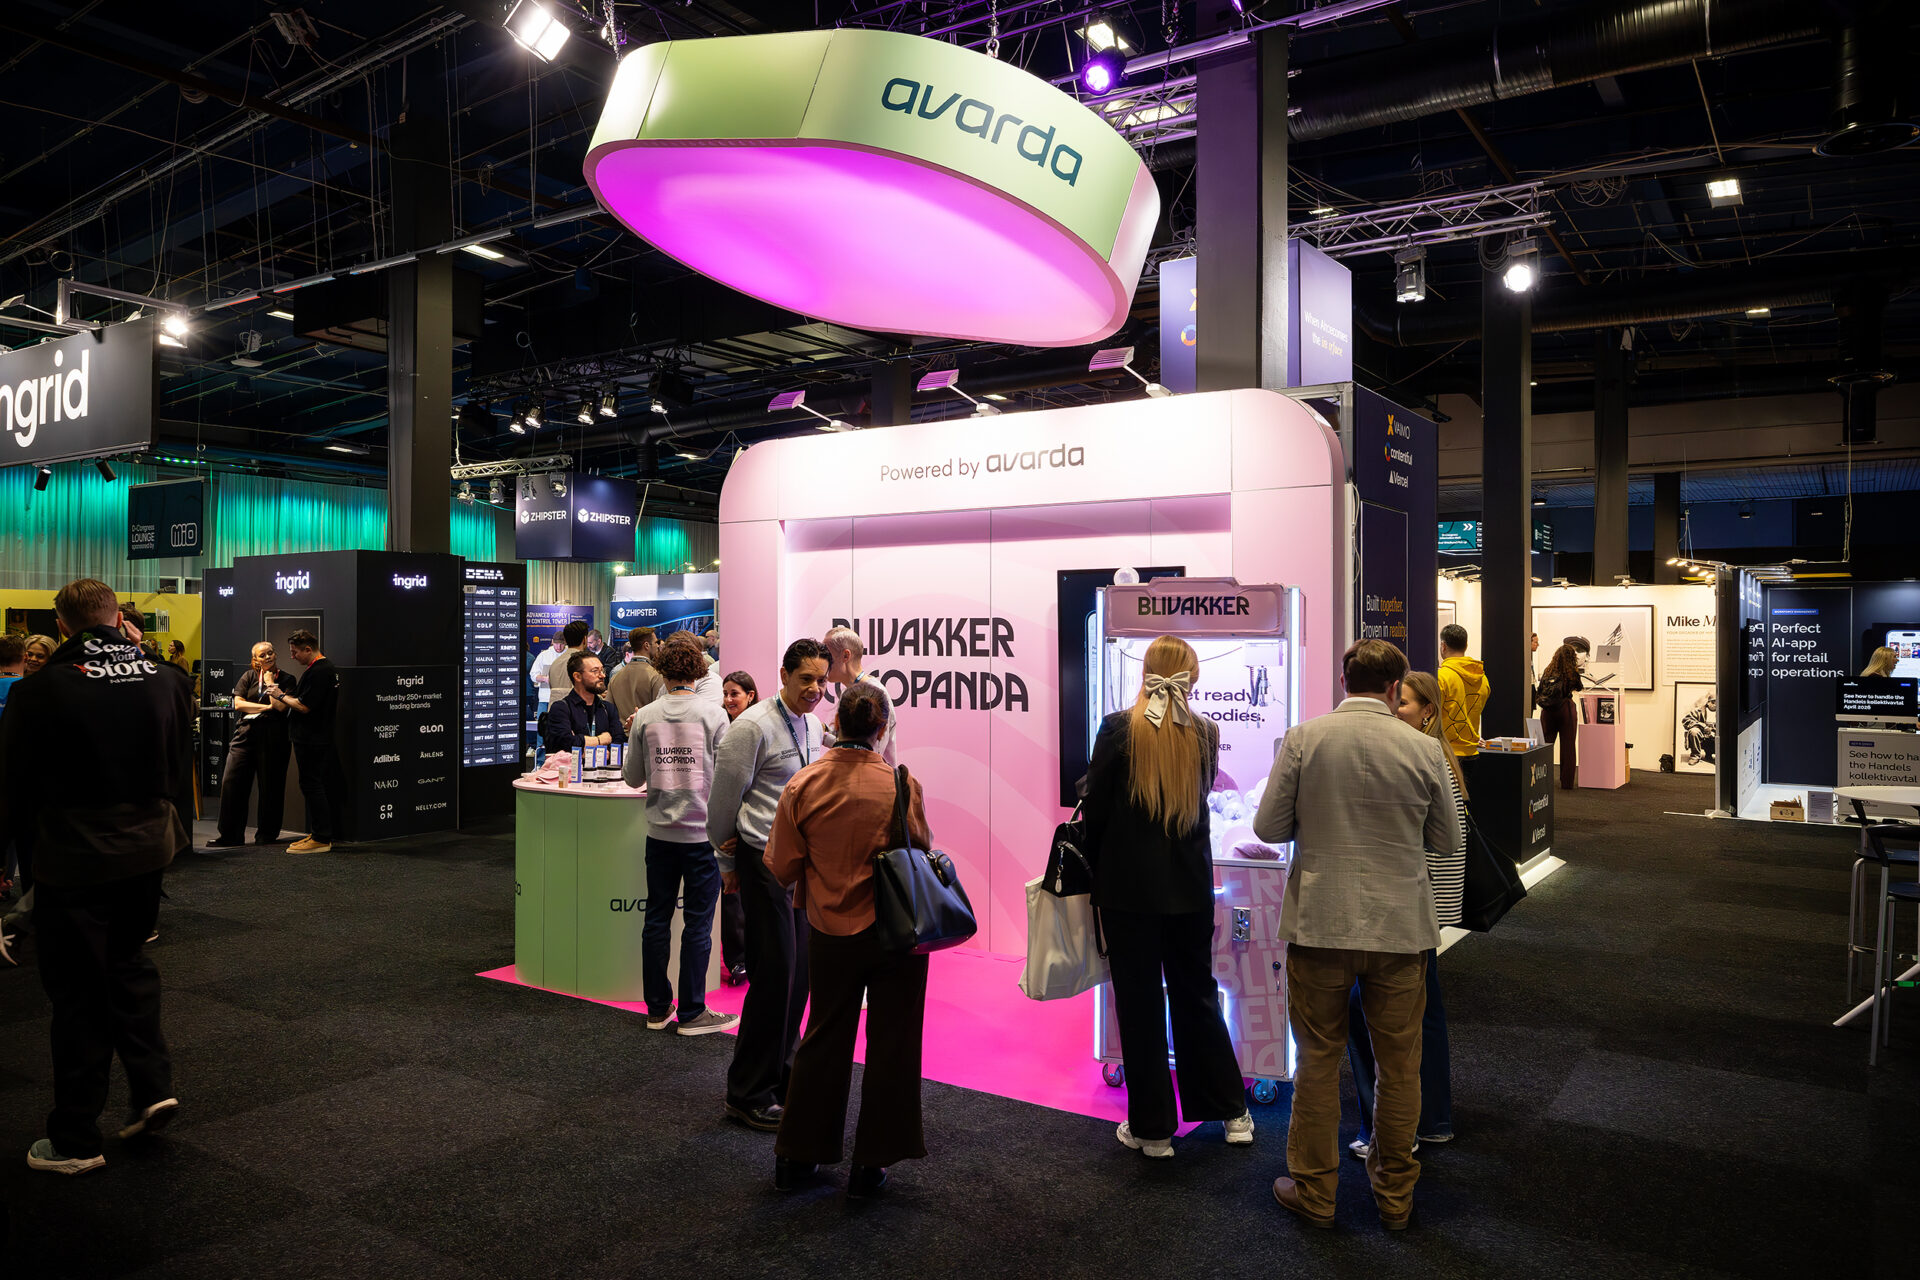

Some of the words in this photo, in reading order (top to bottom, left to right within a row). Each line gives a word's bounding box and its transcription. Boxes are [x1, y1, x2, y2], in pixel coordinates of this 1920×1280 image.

[881, 77, 1083, 188] avarda
[880, 458, 953, 482] Powered
[958, 457, 980, 479] by
[986, 443, 1085, 473] avarda
[1390, 448, 1413, 466] contentful
[1393, 471, 1409, 488] Vercel
[530, 510, 567, 522] ZHIPSTER
[590, 512, 631, 525] ZHIPSTER
[131, 532, 155, 543] LOUNGE
[275, 570, 310, 594] ingrid
[392, 573, 427, 589] ingrid
[218, 586, 234, 597] ingrid
[1137, 596, 1250, 616] BLIVAKKER
[1366, 594, 1380, 611] Built
[625, 608, 657, 617] ZHIPSTER
[1667, 615, 1700, 627] Mike
[1362, 621, 1383, 638] Proven
[1383, 621, 1389, 638] in
[1772, 623, 1821, 633] Perfect
[832, 617, 1015, 657] IVAKKER
[1771, 637, 1817, 650] AI-app
[109, 652, 137, 662] Your
[1771, 651, 1791, 662] for
[1793, 652, 1829, 663] retail
[83, 658, 158, 679] Store
[209, 668, 225, 679] ingrid
[1771, 667, 1845, 679] operations
[396, 675, 424, 687] ingrid
[824, 669, 1029, 712] OPANDA
[390, 702, 410, 710] leading
[1202, 709, 1265, 722] odies.
[373, 724, 400, 732] NORDIC
[655, 747, 692, 755] BLIVAKKER
[1849, 750, 1868, 758] See
[1870, 751, 1892, 759] how
[1894, 752, 1905, 760] to
[373, 754, 400, 763] Adlibris
[1849, 761, 1866, 769] the
[1868, 762, 1912, 771] Handels
[1849, 771, 1918, 783] kollektivavtal
[415, 802, 447, 811] NELLY.COM
